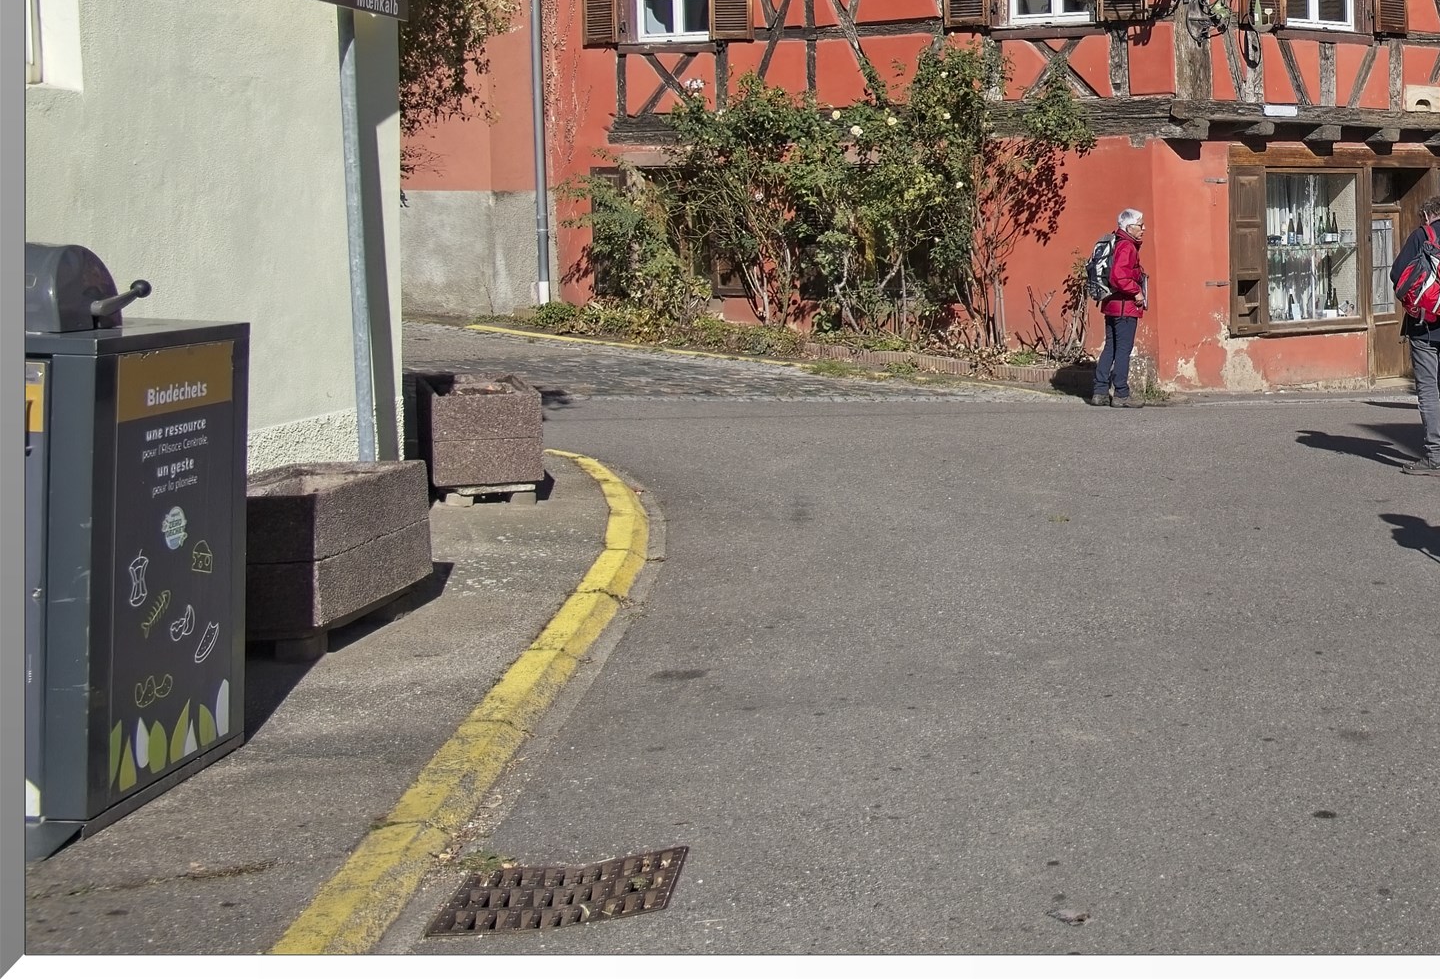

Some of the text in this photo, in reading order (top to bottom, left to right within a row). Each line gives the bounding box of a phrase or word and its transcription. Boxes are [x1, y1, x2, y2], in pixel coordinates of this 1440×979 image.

[147, 381, 208, 406] Biodéchets
[146, 419, 207, 441] une ressource
[142, 448, 157, 463] pour
[157, 457, 194, 478] un geste
[152, 484, 167, 499] pour
[168, 480, 174, 491] la
